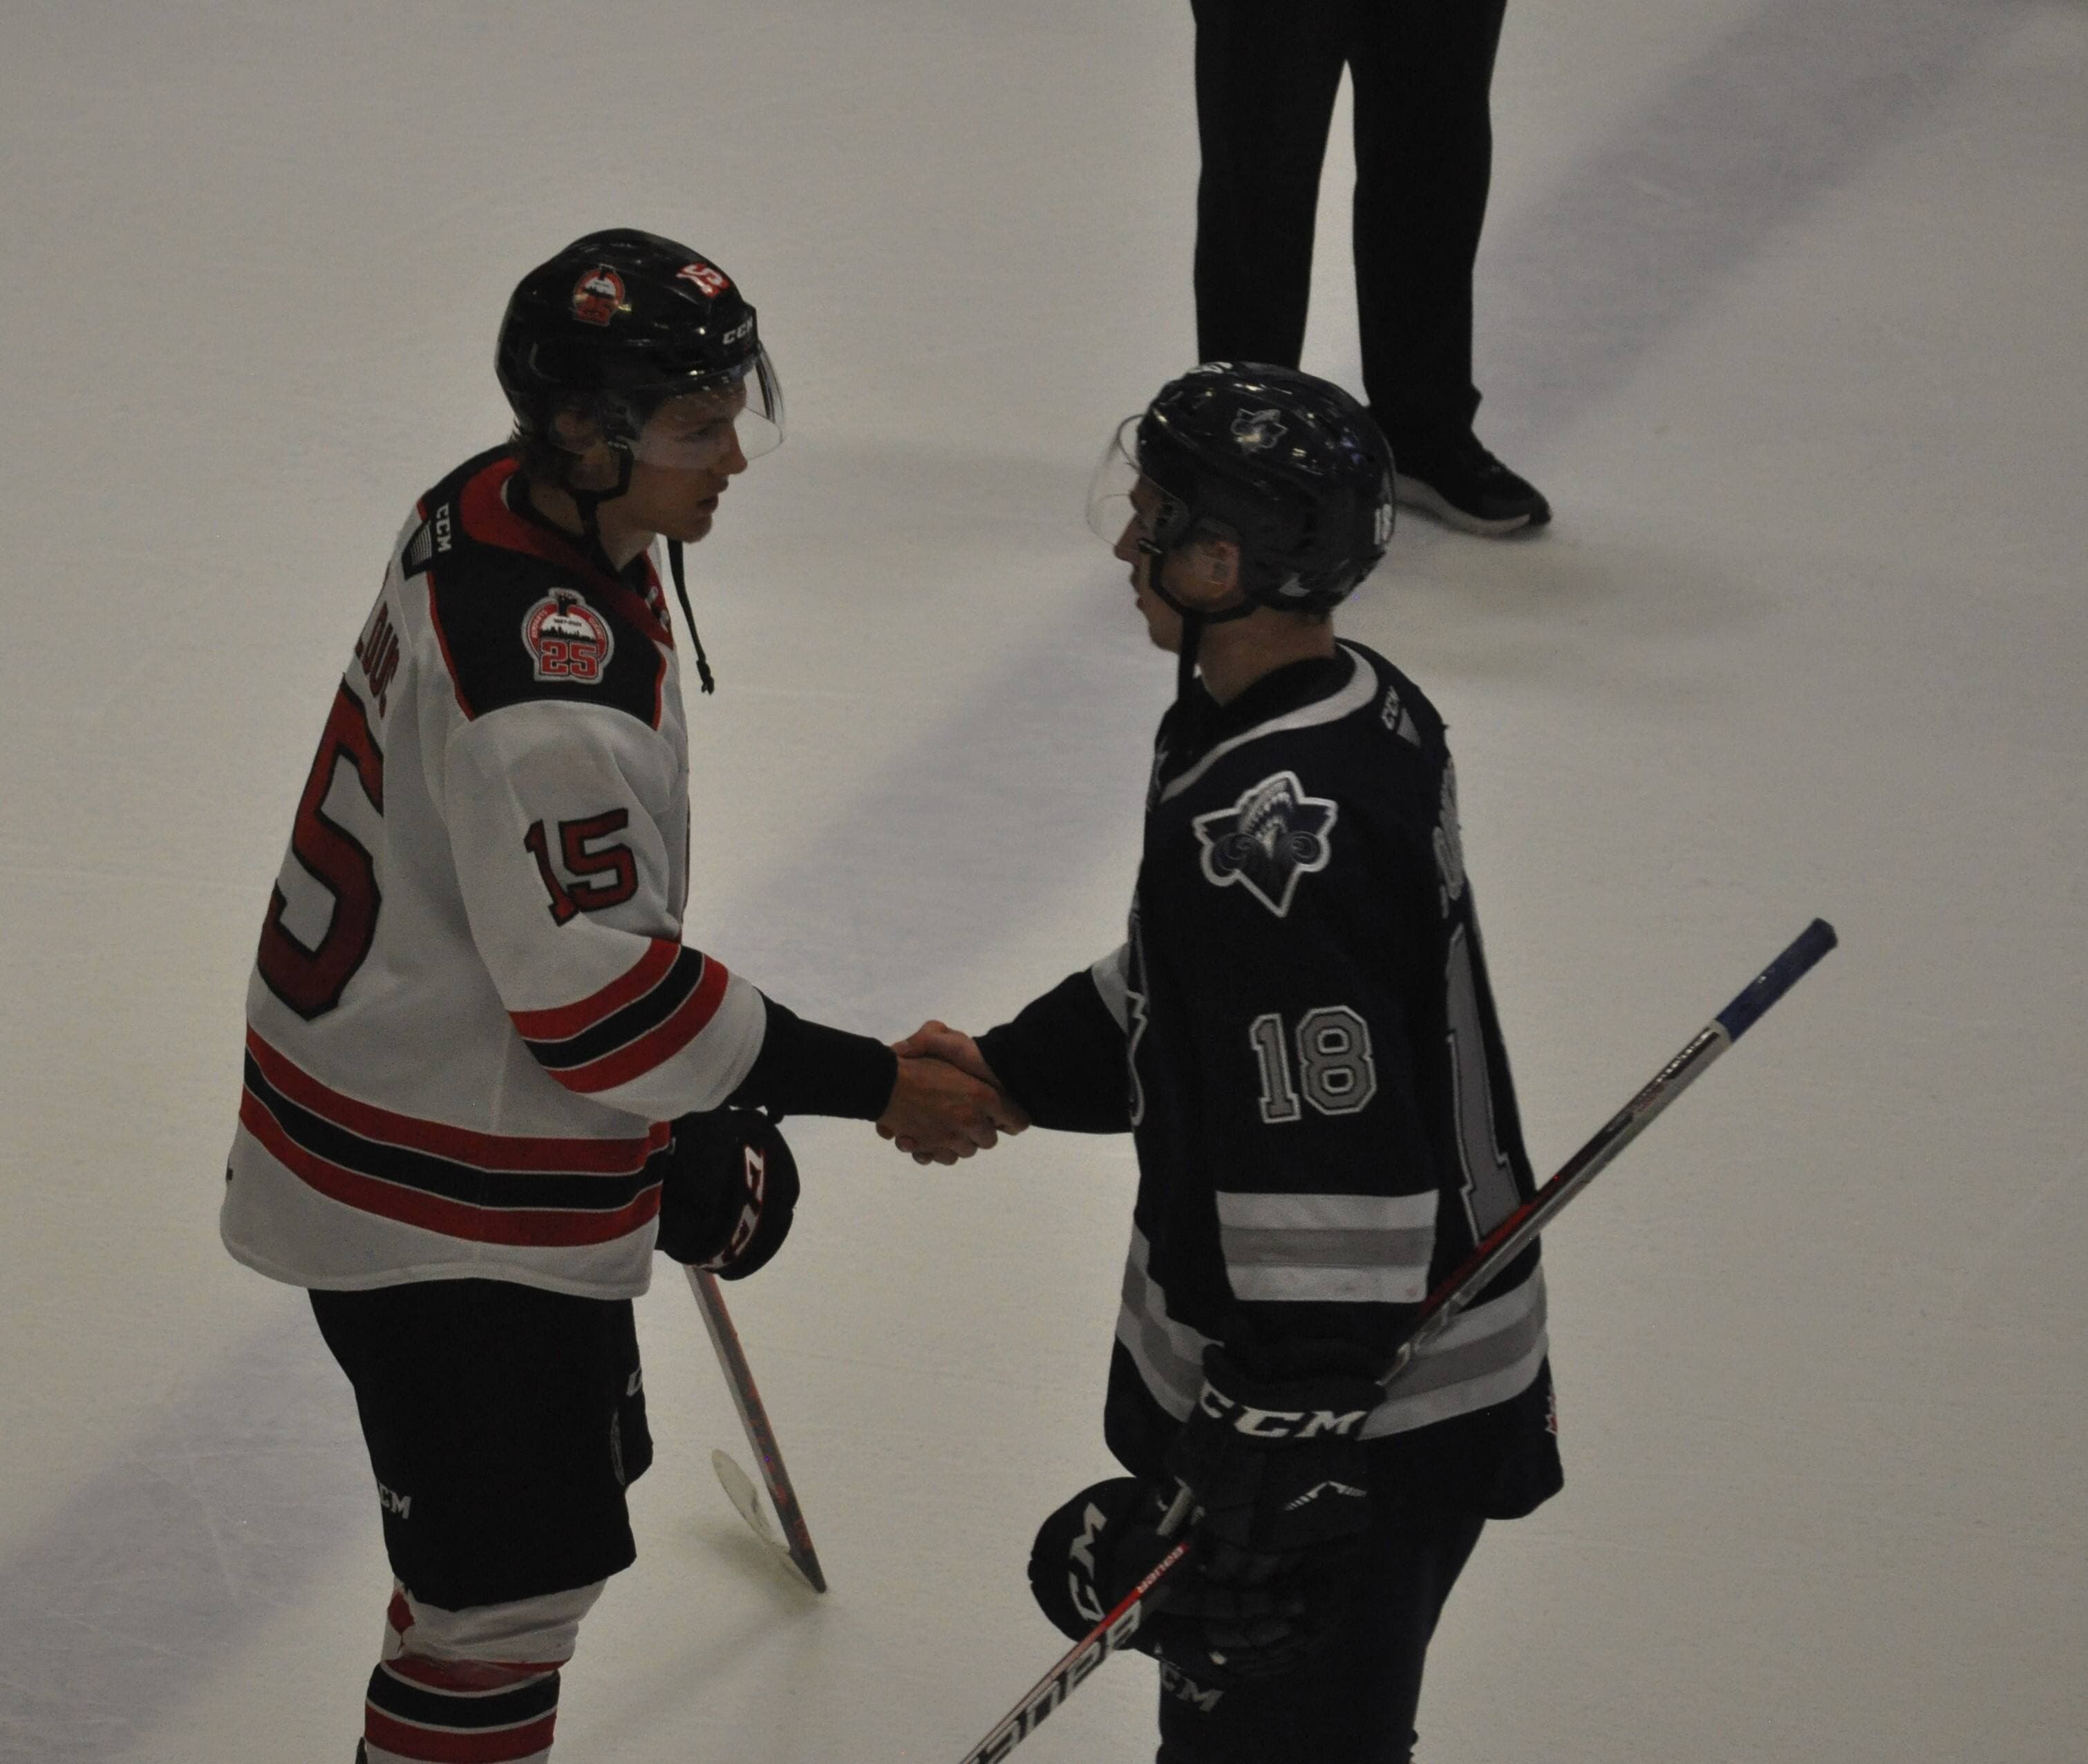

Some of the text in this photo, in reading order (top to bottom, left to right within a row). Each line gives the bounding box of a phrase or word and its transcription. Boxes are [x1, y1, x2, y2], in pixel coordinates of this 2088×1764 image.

[675, 262, 731, 299] 15
[435, 502, 453, 553] CCM
[540, 639, 599, 679] 25
[523, 807, 639, 928] 15
[1249, 1004, 1378, 1125] 18
[1199, 1379, 1369, 1438] CCM
[968, 1598, 1142, 1764] BAUE
